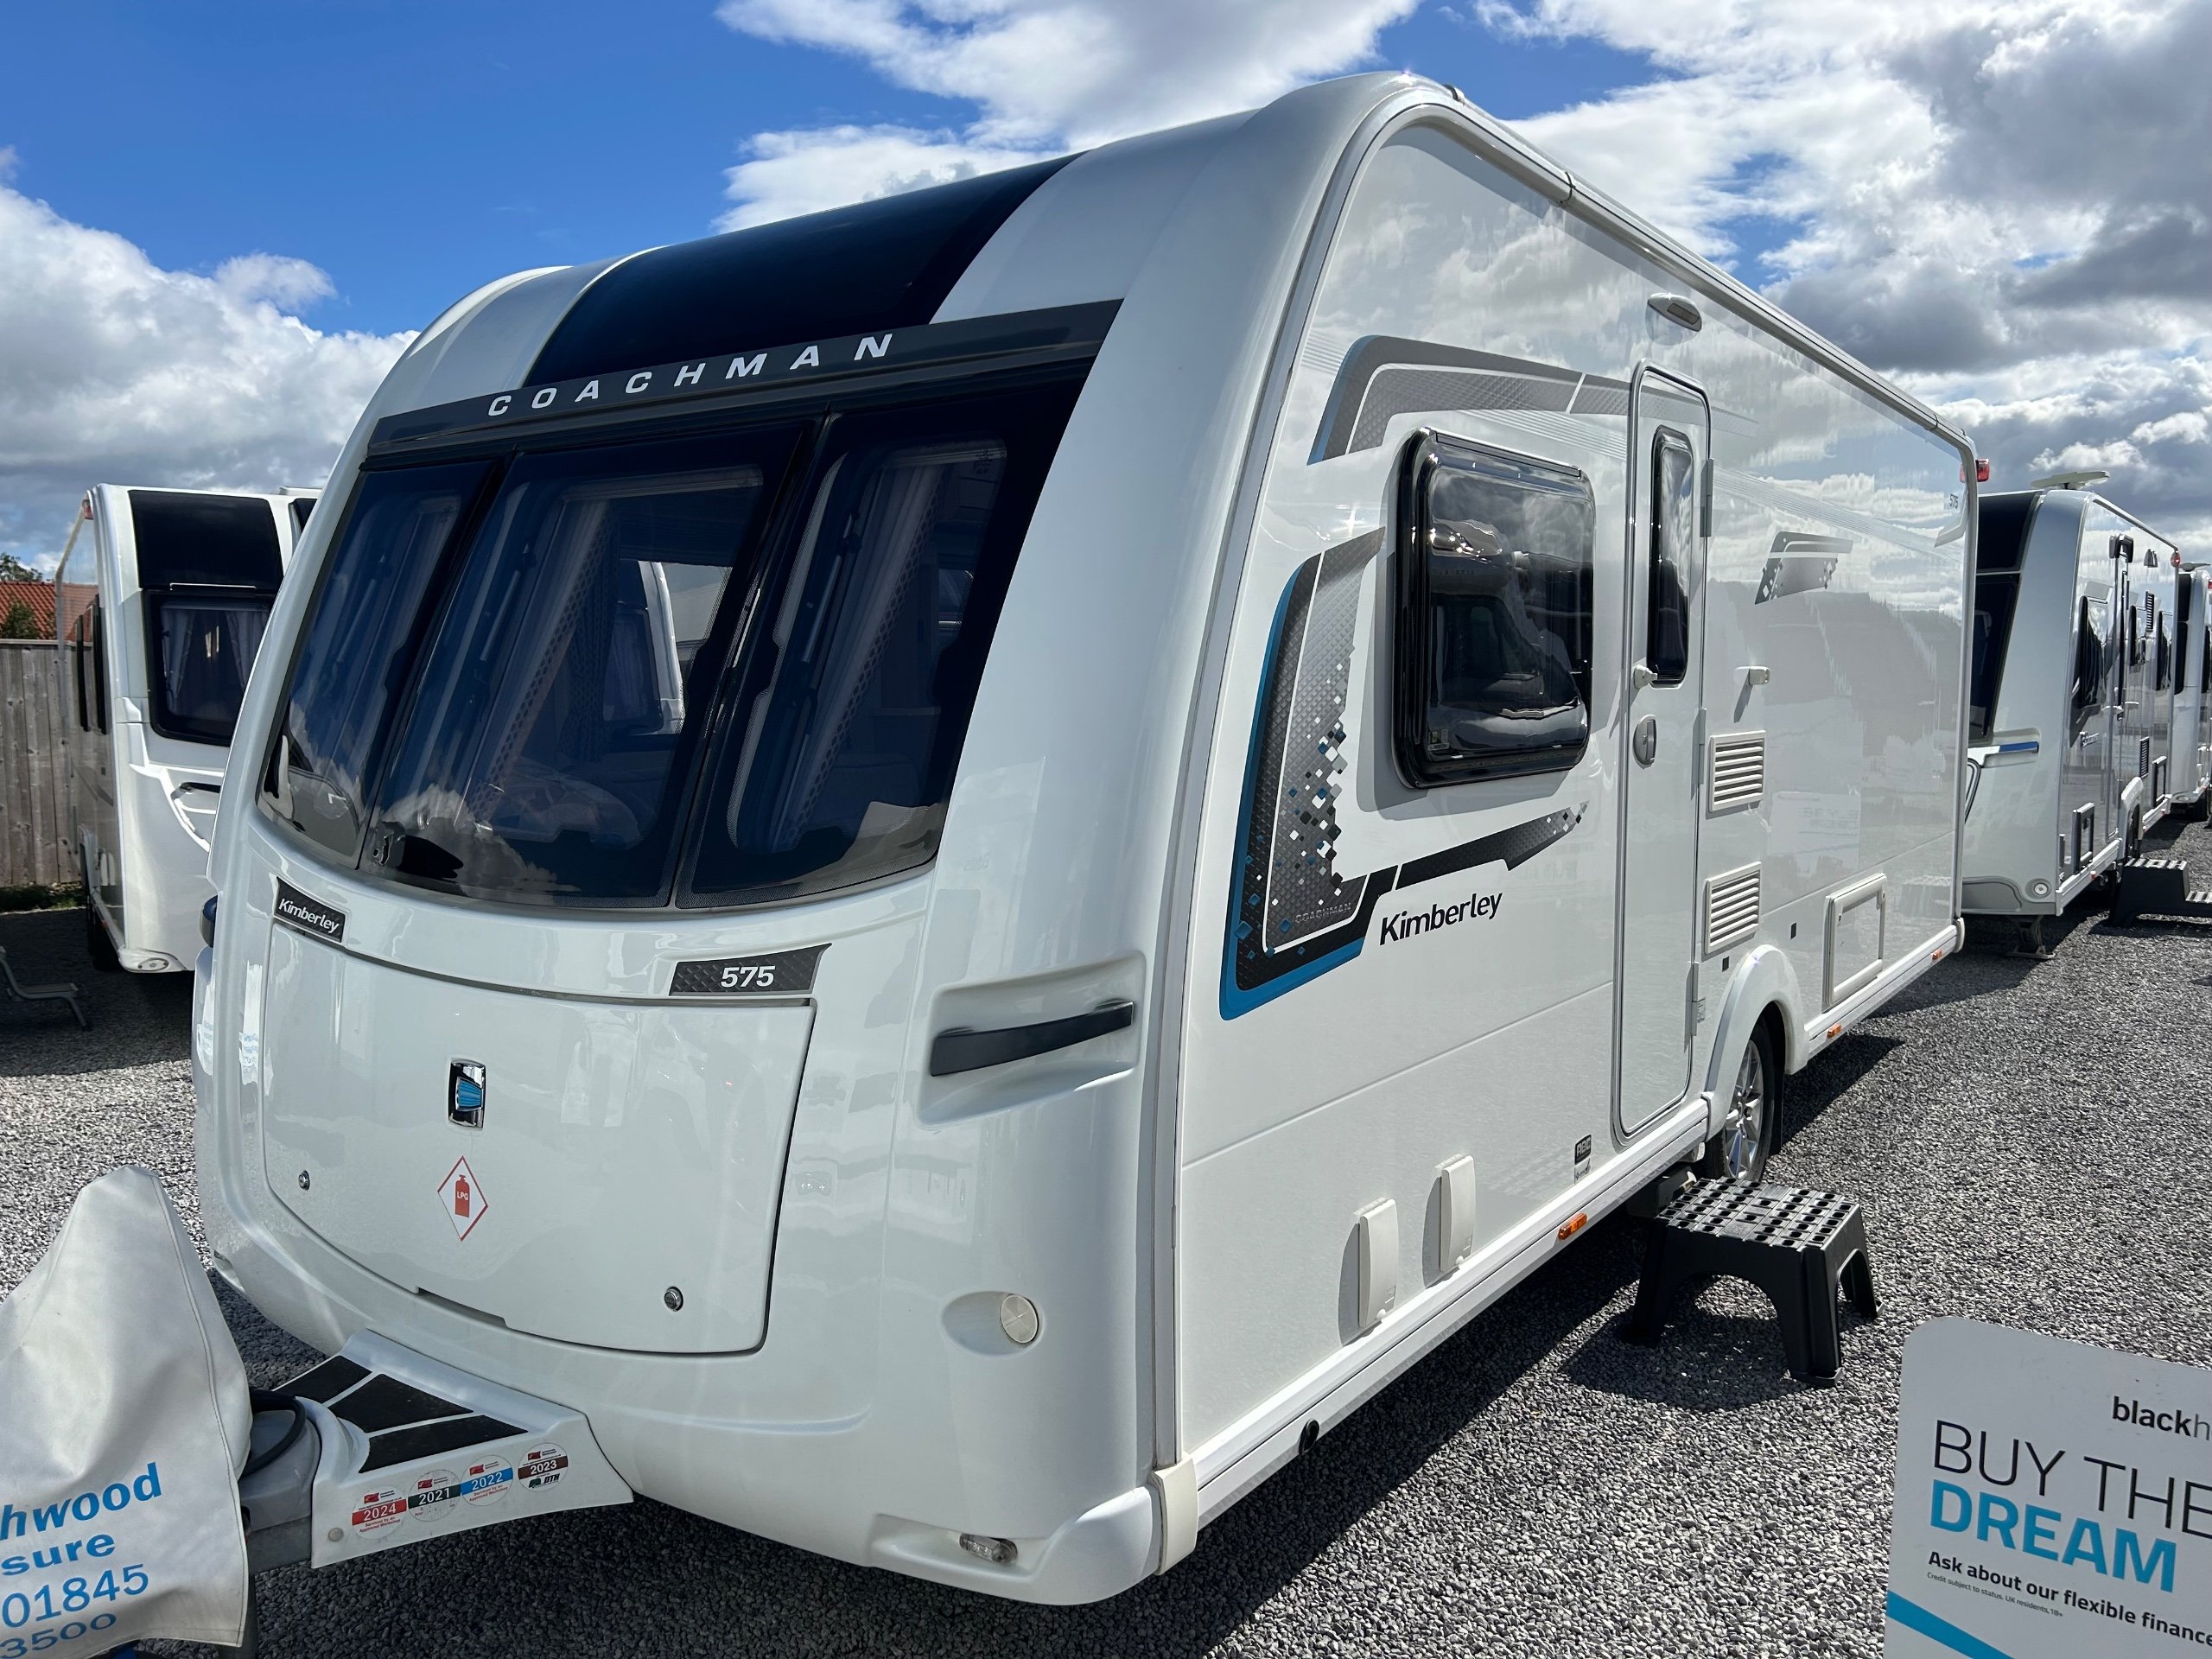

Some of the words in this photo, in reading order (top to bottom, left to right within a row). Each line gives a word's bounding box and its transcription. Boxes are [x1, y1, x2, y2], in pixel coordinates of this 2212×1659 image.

[487, 333, 893, 416] COACHMAN
[278, 898, 340, 934] Kimberley
[1379, 893, 1503, 946] Kimberley
[721, 965, 776, 988] 575
[456, 1191, 469, 1201] LPG
[2112, 1395, 2212, 1440] blackh
[472, 1471, 504, 1491] 2022
[530, 1460, 557, 1475] 2023
[1934, 1420, 2066, 1497] BUY
[2083, 1455, 2212, 1540] THE
[0, 1461, 162, 1541] hwood
[364, 1503, 397, 1522] 2024
[419, 1487, 449, 1505] 2021
[1, 1534, 116, 1576] sure
[1929, 1478, 2177, 1593] DREAM
[2, 1563, 149, 1629] 01845
[1927, 1572, 1947, 1583] Credit
[1948, 1577, 1972, 1591] subject
[1928, 1551, 1962, 1574] Ask
[1967, 1565, 2022, 1592] about
[2026, 1582, 2059, 1601] our
[2063, 1590, 2136, 1624] flexible
[0, 1612, 118, 1659] 3500
